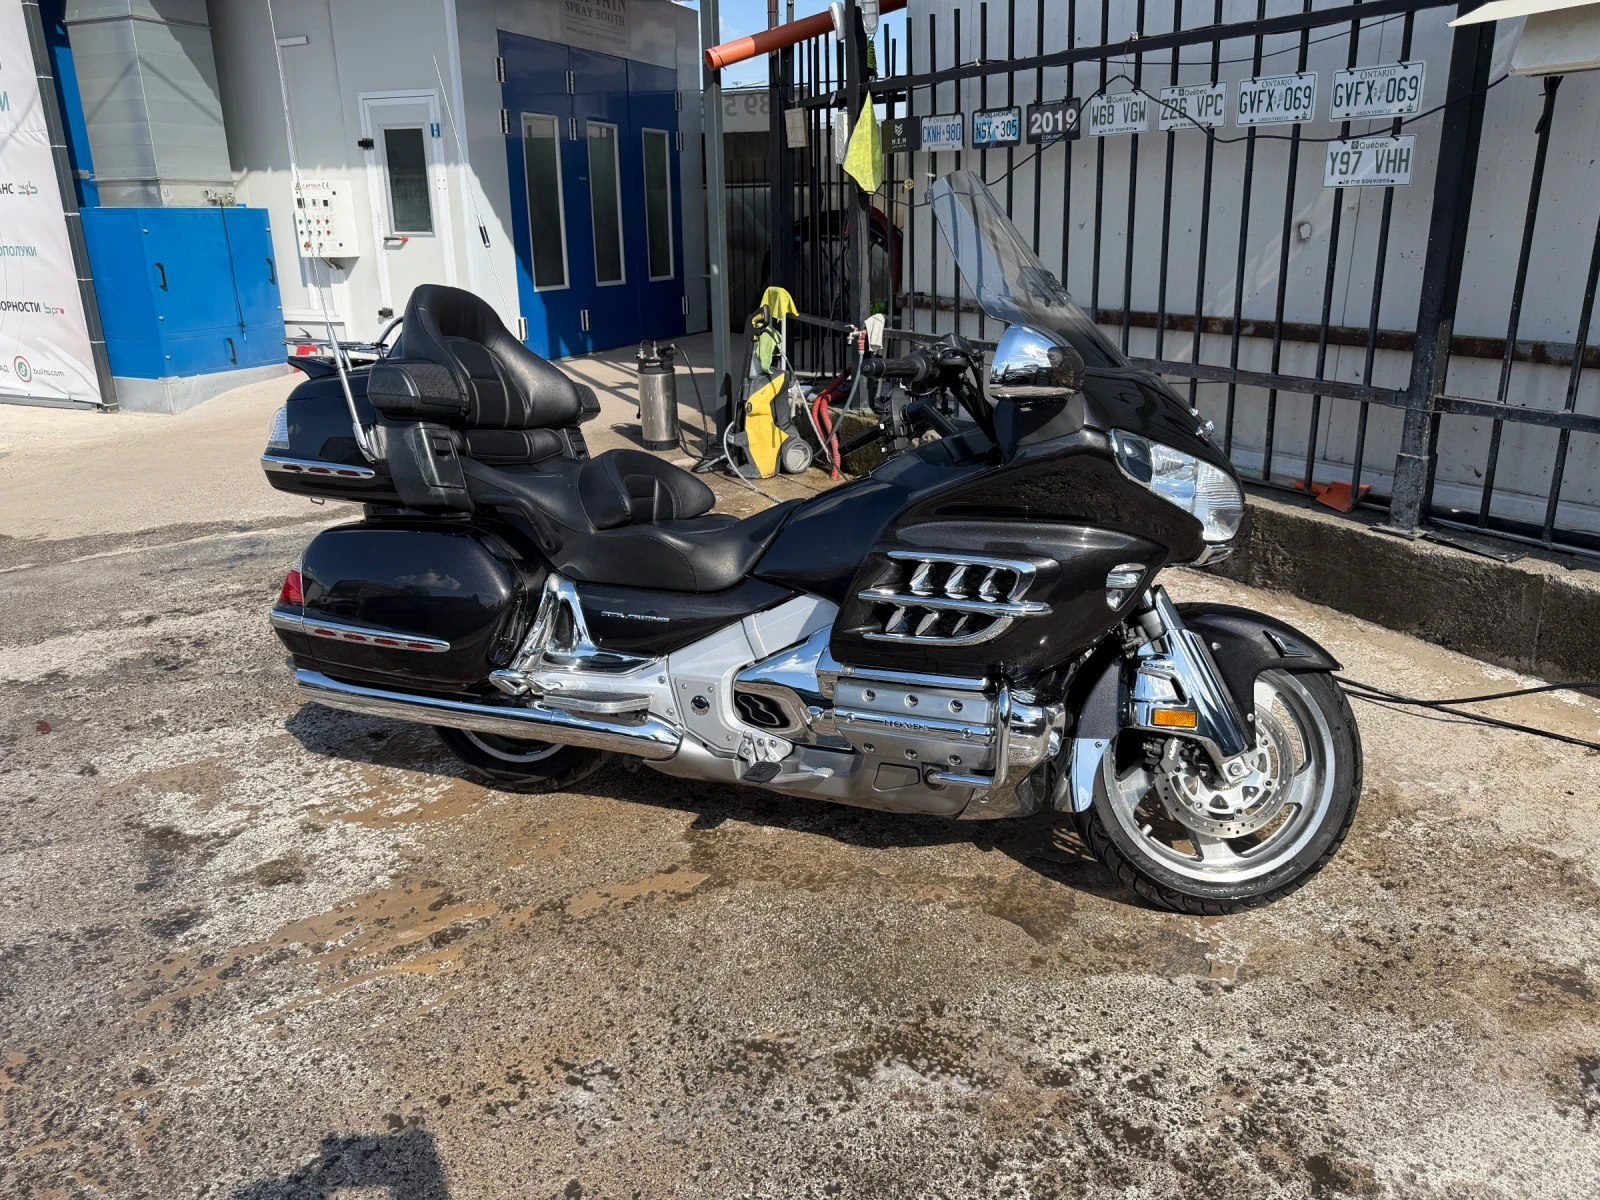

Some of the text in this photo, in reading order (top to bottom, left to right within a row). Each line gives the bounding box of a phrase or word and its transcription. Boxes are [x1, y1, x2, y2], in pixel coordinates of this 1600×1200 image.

[565, 1, 592, 18] SPRAY
[596, 10, 625, 26] BOOTH
[1261, 79, 1293, 89] ONTARIO
[1360, 69, 1396, 80] ONTARIO
[1184, 88, 1207, 97] Québec
[1240, 85, 1312, 114] GVFX 069
[1334, 75, 1419, 108] GVFX 069
[1092, 100, 1147, 126] W68 VGW
[1161, 94, 1223, 120] Z26 VPC
[976, 119, 1017, 140] NSX 305
[1031, 108, 1077, 134] 2019
[922, 123, 961, 143] CKNH 980
[1359, 141, 1389, 149] Québec
[1330, 147, 1411, 176] Y97 VHH
[0, 300, 41, 313] ОРНОСТИ
[884, 720, 929, 732] HONDA
